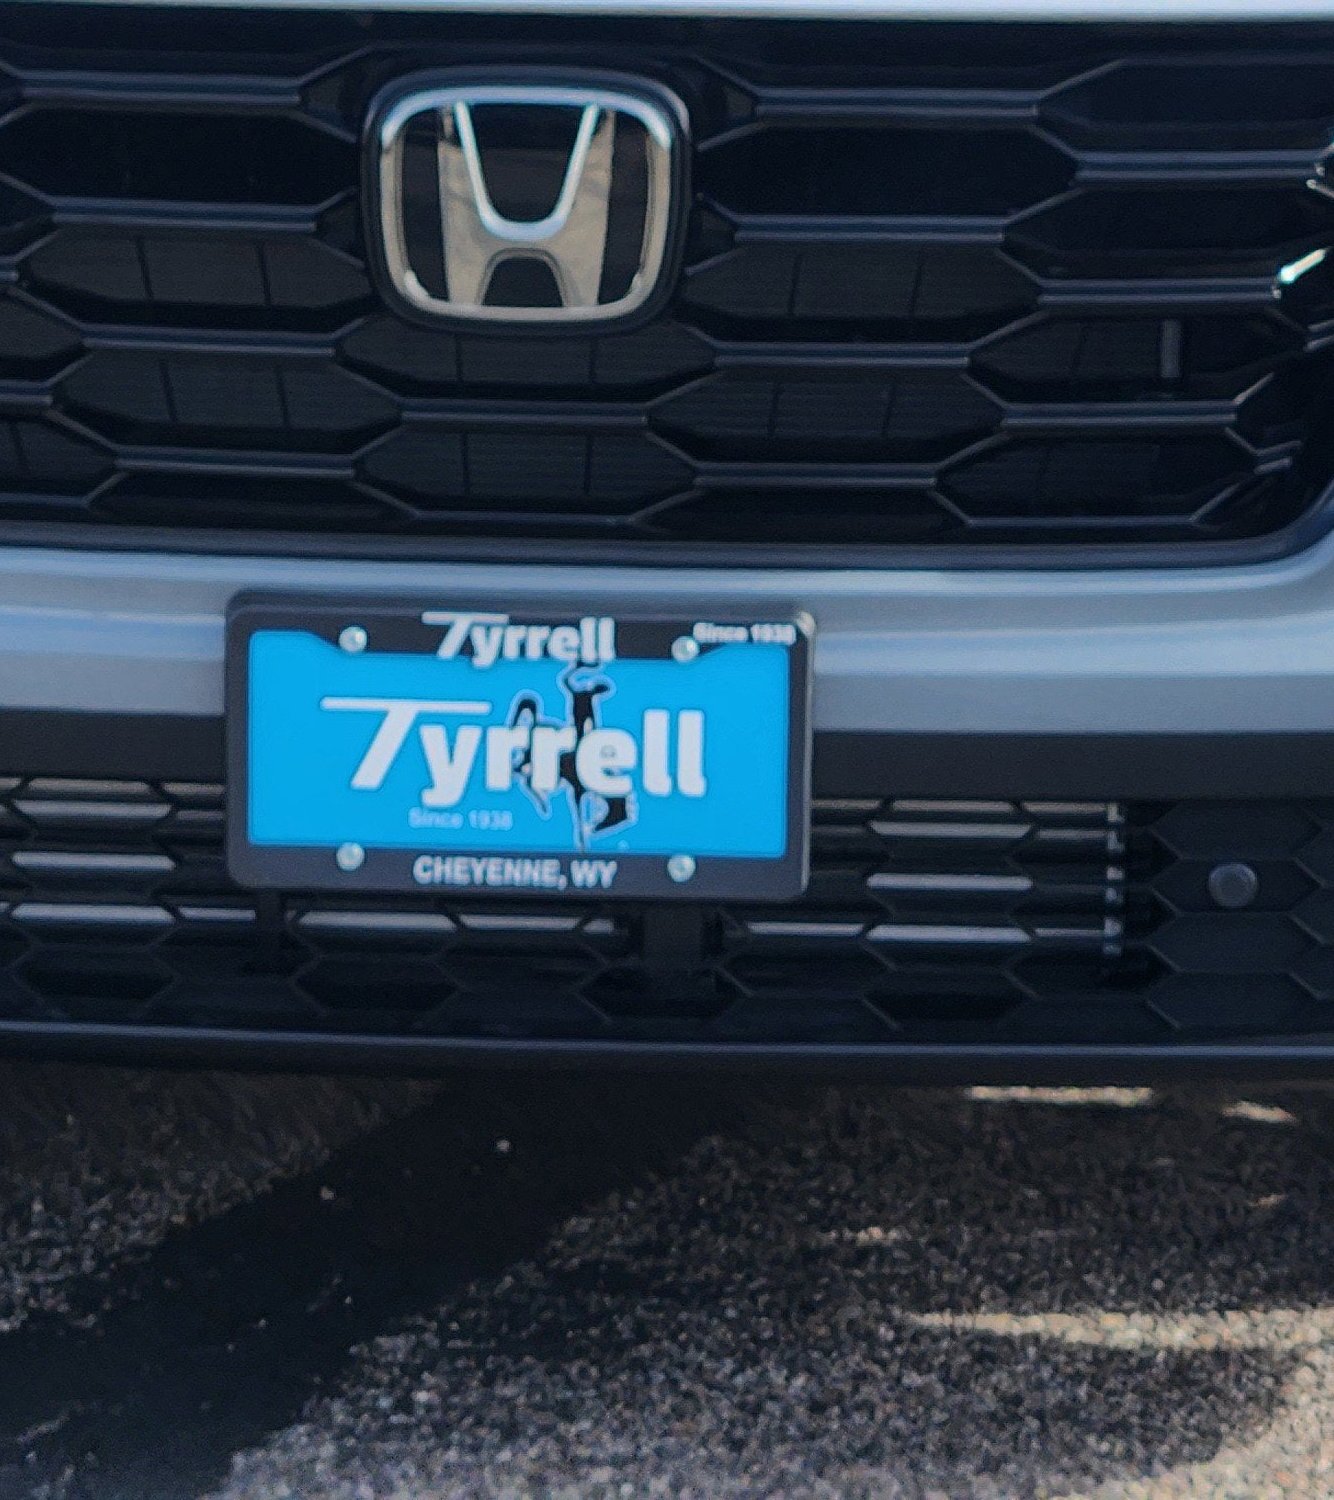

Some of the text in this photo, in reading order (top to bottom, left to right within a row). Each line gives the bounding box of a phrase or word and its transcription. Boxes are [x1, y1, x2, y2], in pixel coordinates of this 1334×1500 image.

[421, 611, 616, 668] Tyrrell
[320, 696, 706, 807] Tyrrell
[413, 854, 618, 891] CHEYENNE, WY
